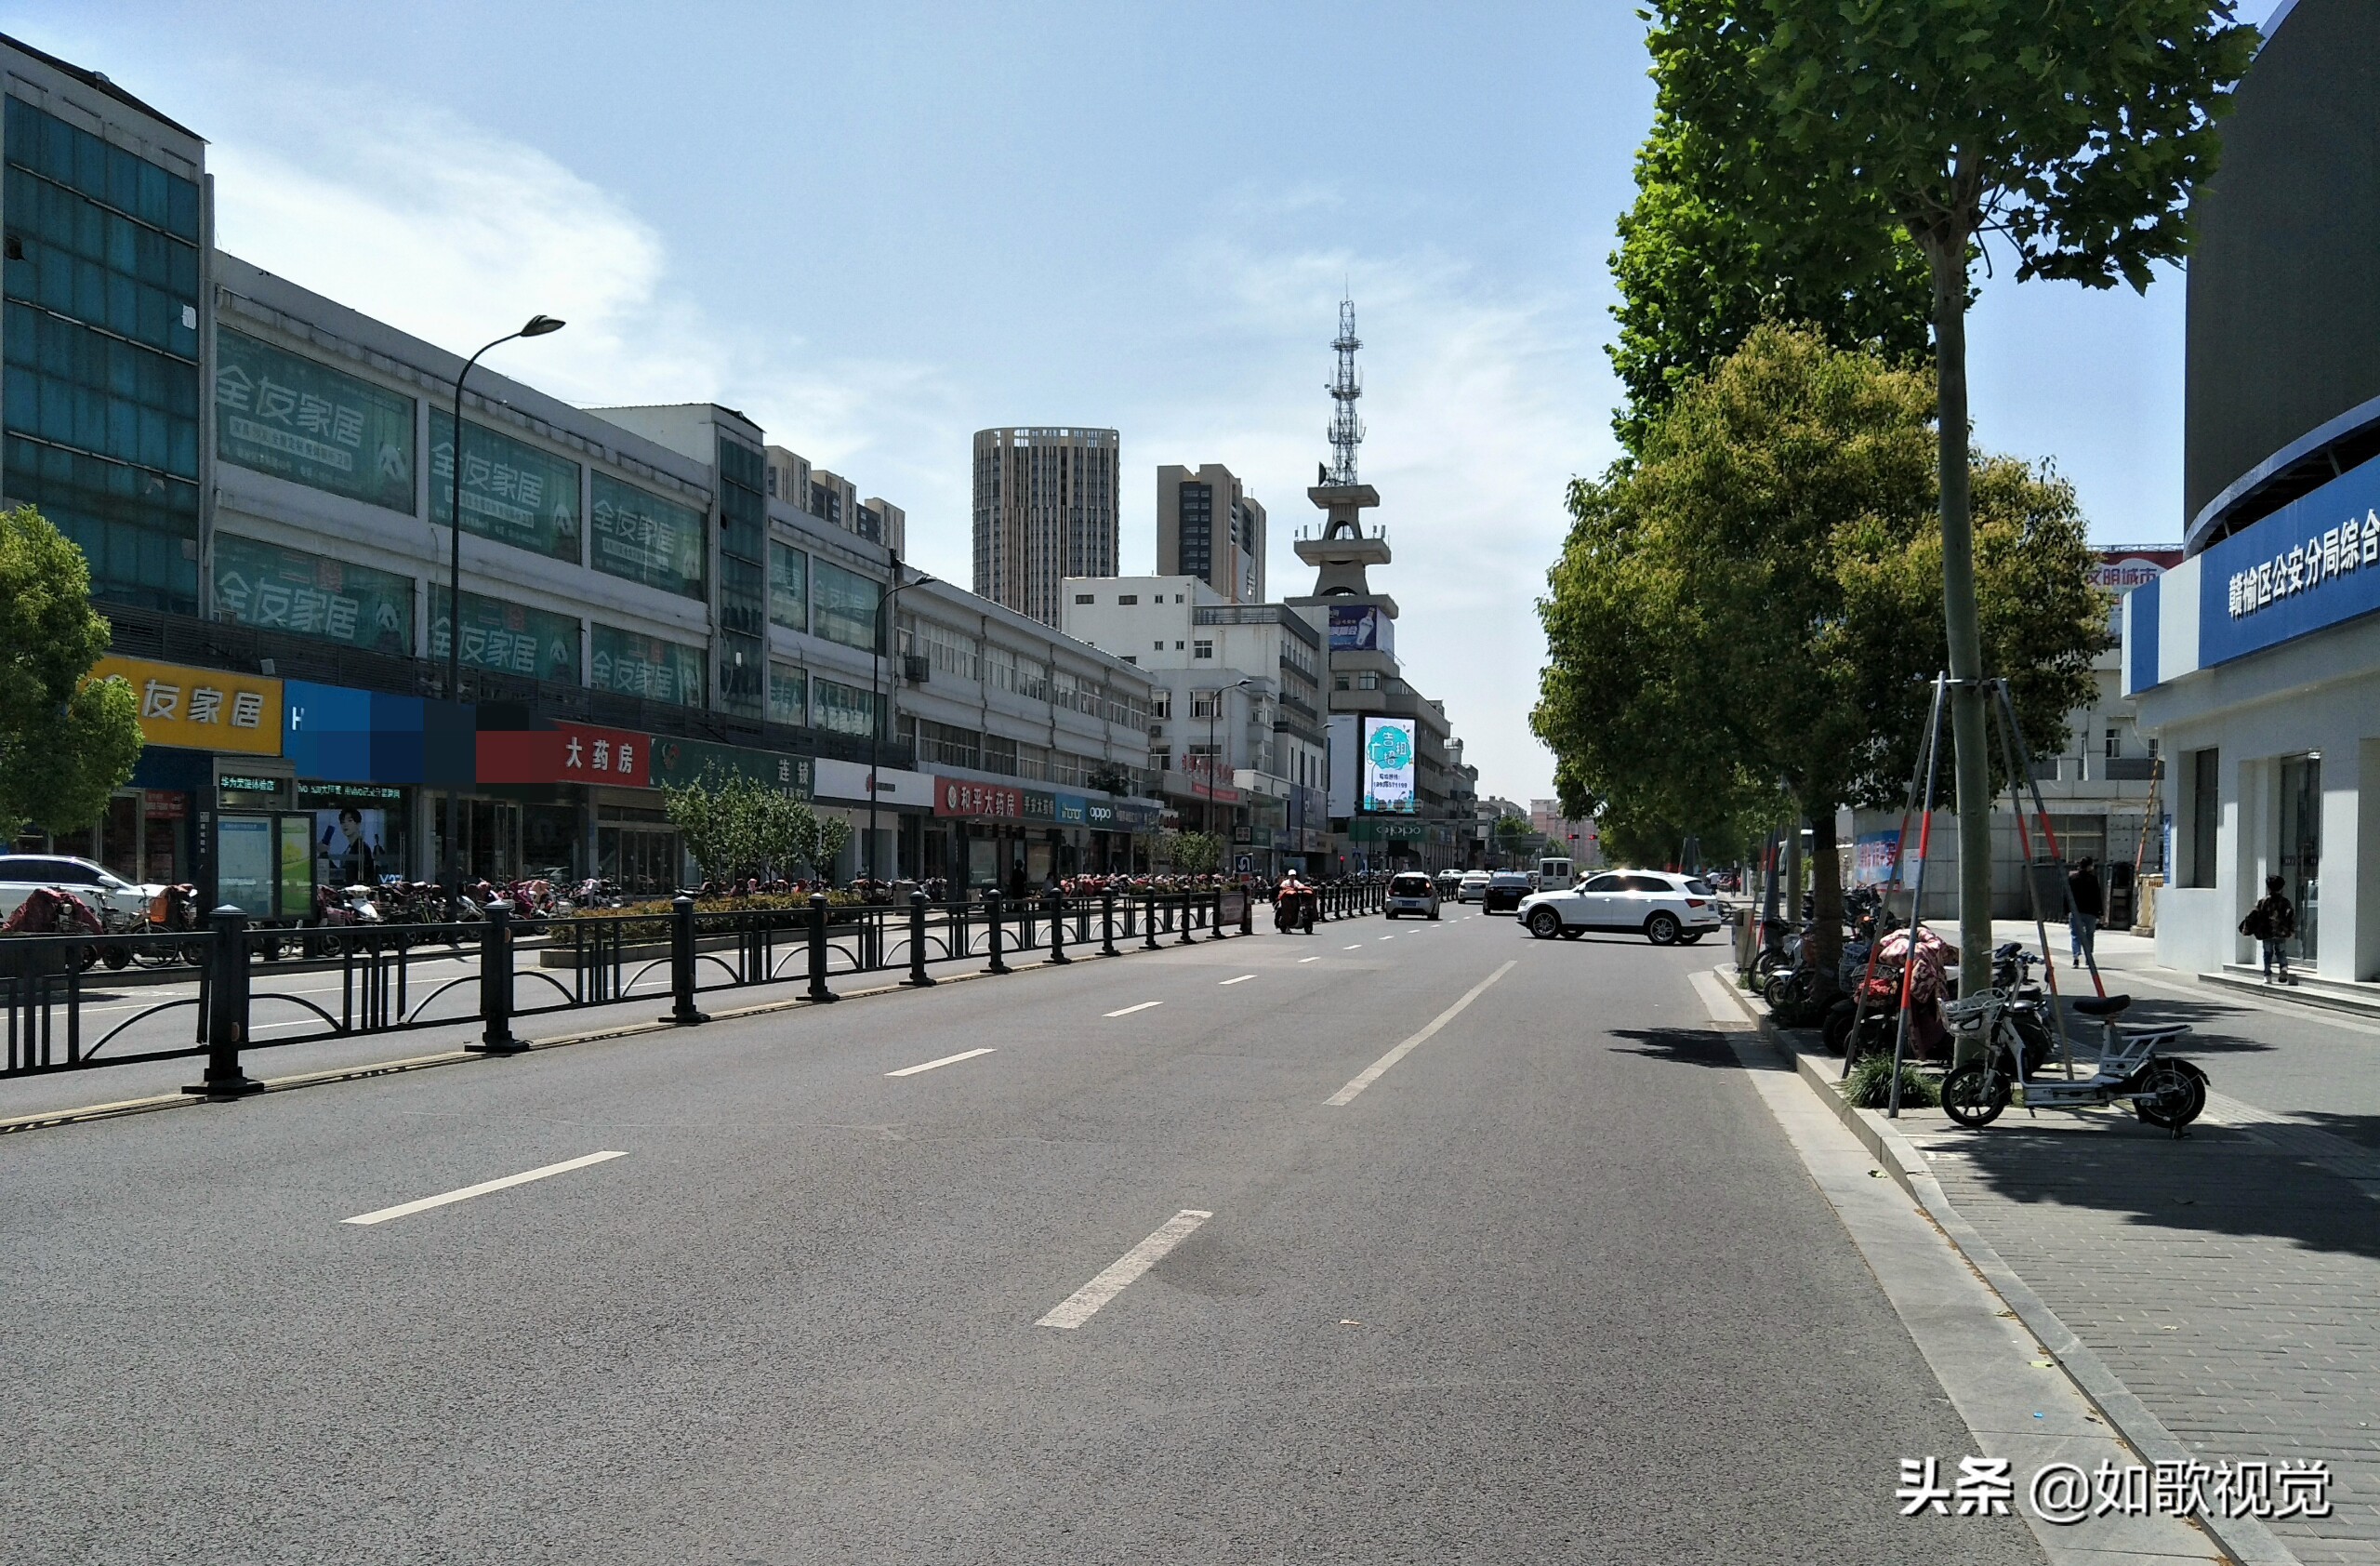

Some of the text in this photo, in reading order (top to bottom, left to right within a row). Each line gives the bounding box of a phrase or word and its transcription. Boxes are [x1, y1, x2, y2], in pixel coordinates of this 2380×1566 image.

[217, 365, 364, 448] 全友家居
[431, 442, 544, 508] 全友家居
[2228, 509, 2380, 617] 赣榆区公安分局综合
[219, 571, 359, 640] 全友家居
[103, 674, 264, 729] 友家居
[565, 737, 633, 774] 大药房
[777, 758, 809, 786] 连锁
[960, 786, 1014, 816] 和平大药房
[1090, 806, 1111, 821] oppo
